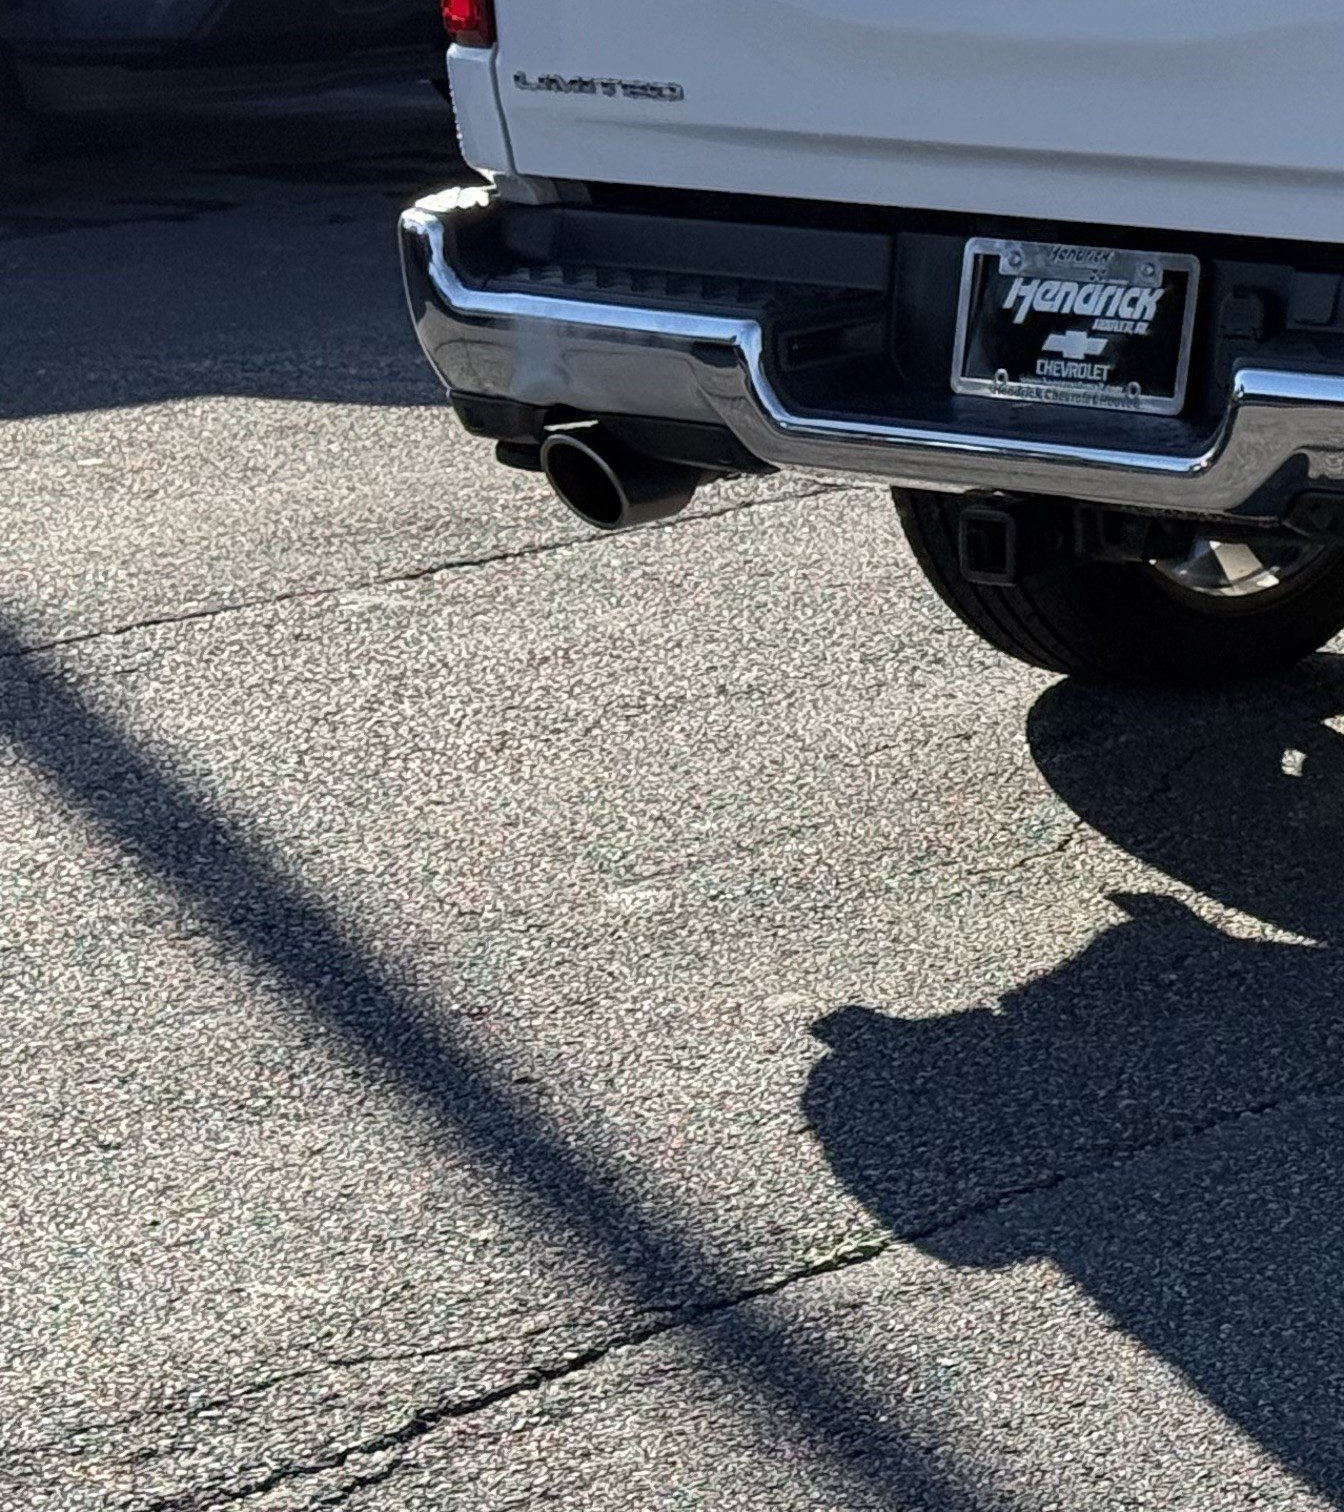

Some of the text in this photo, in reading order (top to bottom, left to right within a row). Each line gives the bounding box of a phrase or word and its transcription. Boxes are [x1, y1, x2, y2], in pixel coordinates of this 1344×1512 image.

[512, 70, 685, 102] LIMITED
[1001, 276, 1166, 325] Hendrick
[1035, 358, 1112, 382] CHEVROLET
